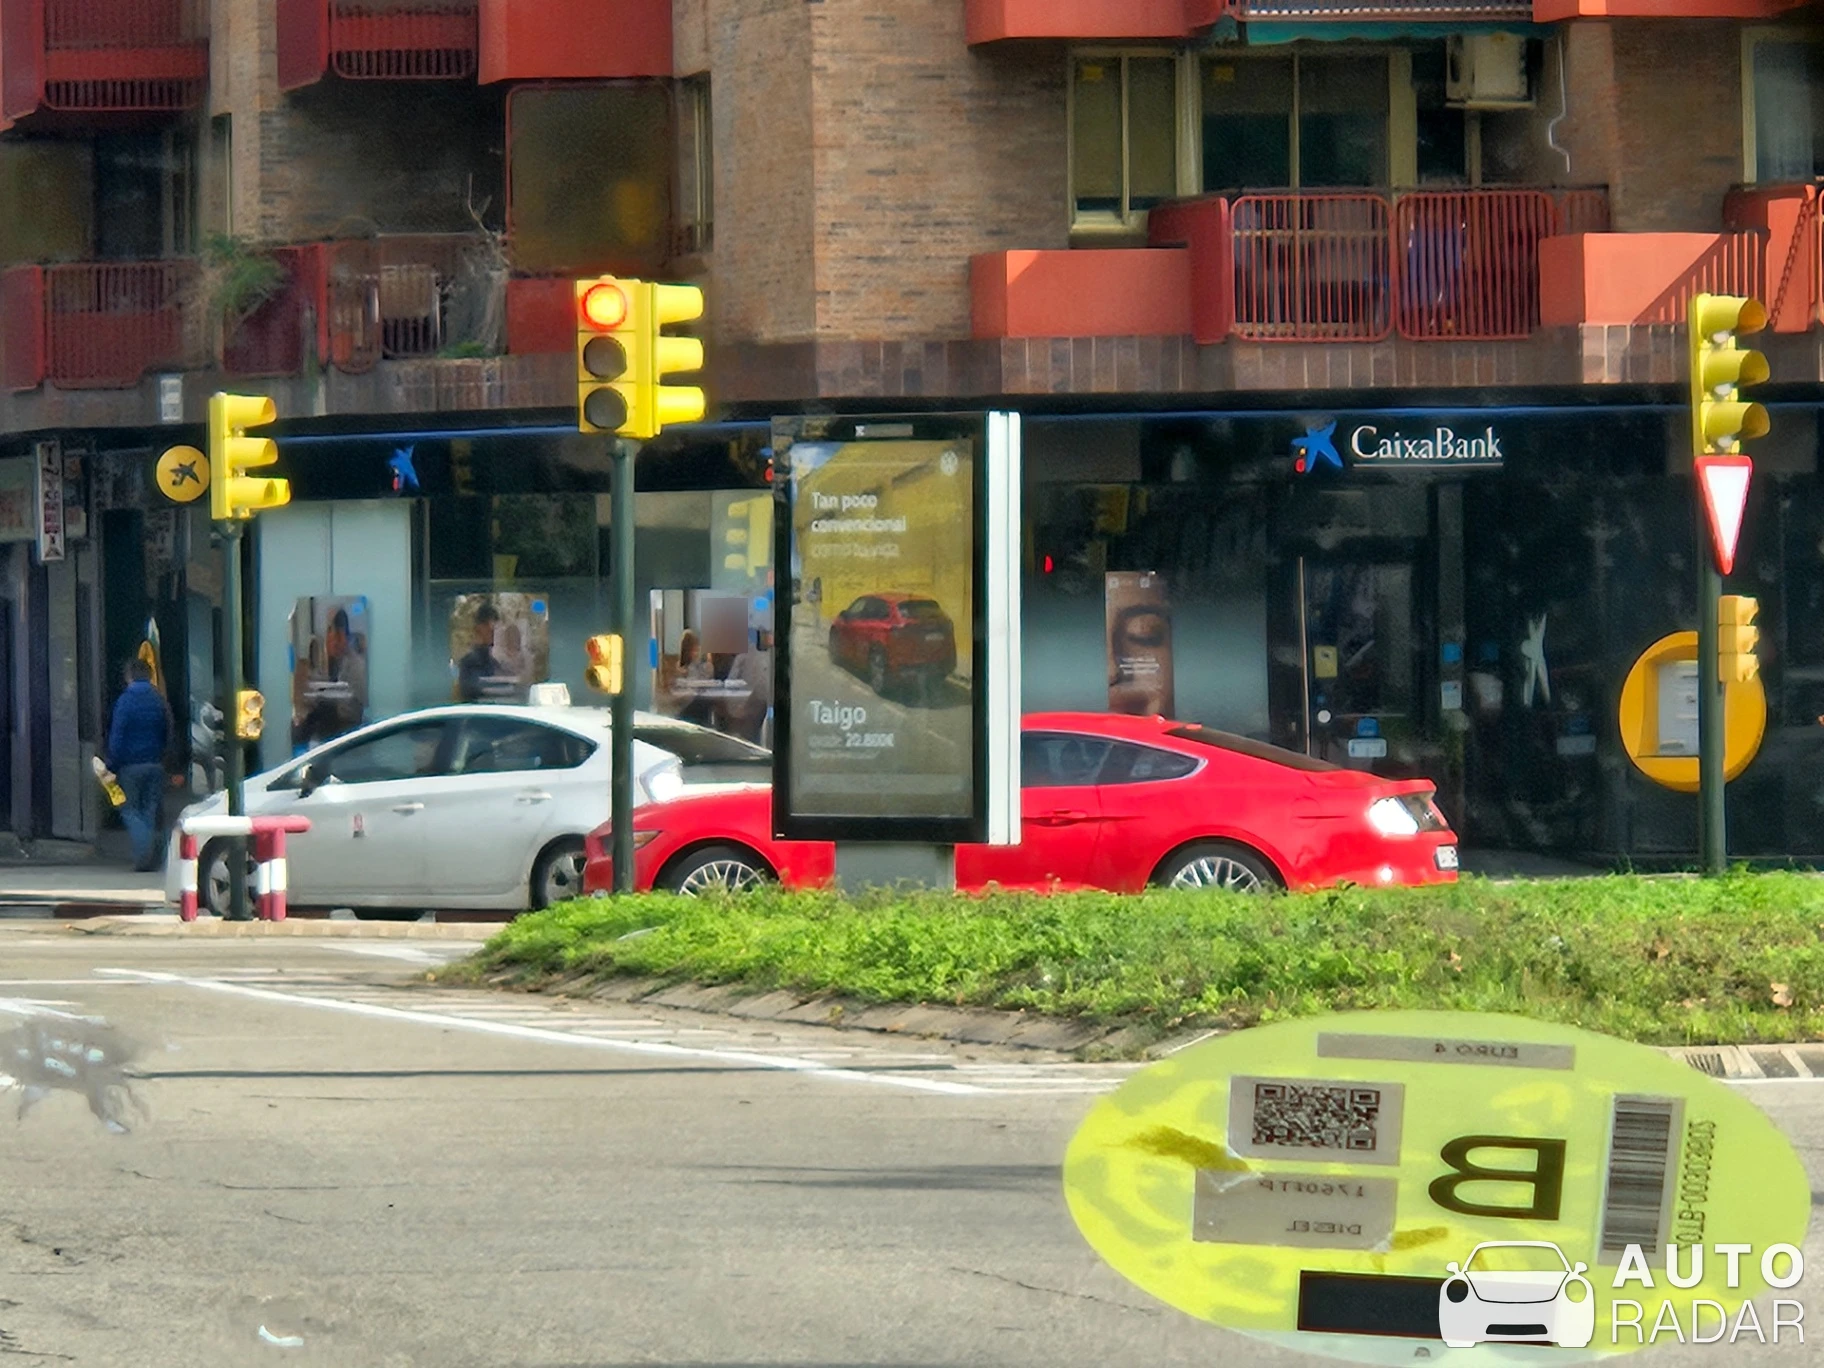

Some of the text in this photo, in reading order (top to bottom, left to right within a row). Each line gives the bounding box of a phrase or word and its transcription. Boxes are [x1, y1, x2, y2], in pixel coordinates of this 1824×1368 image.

[1351, 425, 1503, 460] CaixaBank
[812, 491, 878, 512] Tan poco
[810, 700, 866, 730] Taigo
